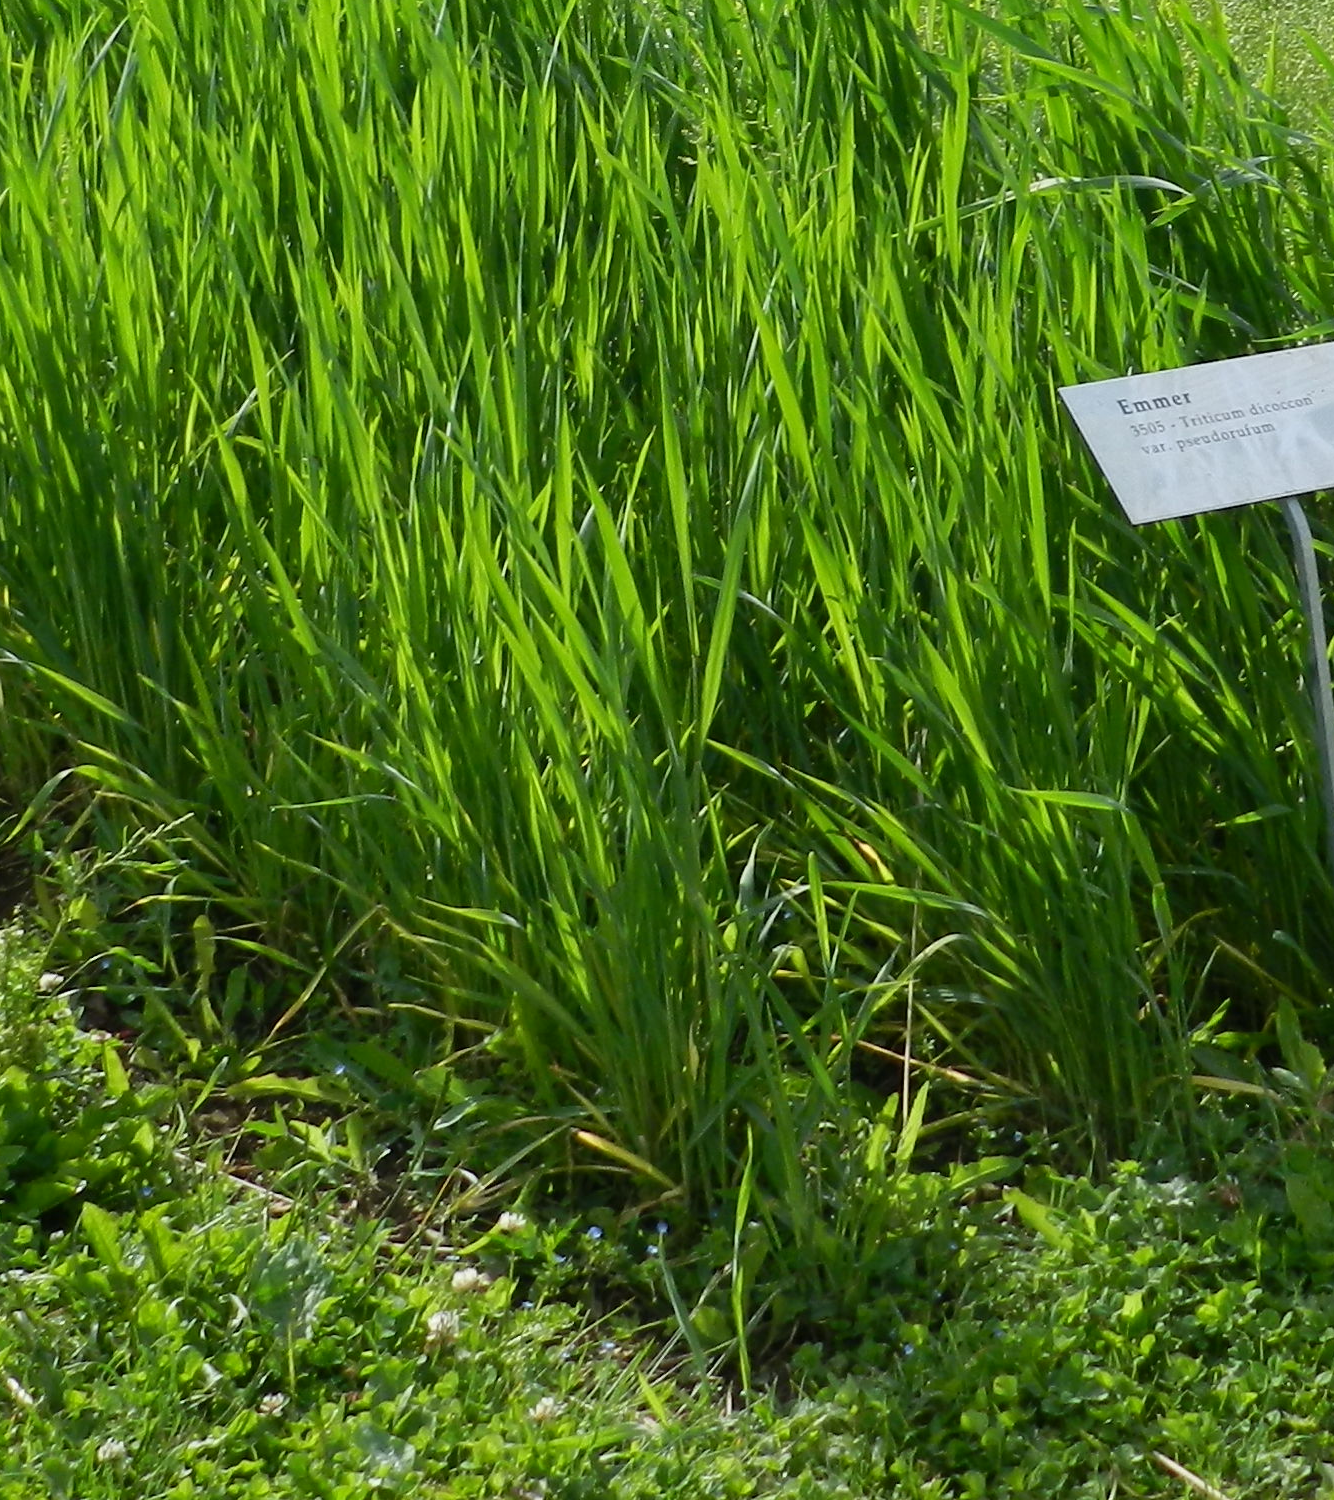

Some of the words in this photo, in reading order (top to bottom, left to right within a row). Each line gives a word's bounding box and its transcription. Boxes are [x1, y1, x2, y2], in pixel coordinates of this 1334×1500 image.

[1117, 391, 1192, 416] Emmer
[1130, 419, 1166, 438] 3505
[1179, 409, 1245, 429] Triticum
[1250, 395, 1314, 417] dicoccon
[1141, 441, 1173, 456] var.
[1177, 422, 1276, 453] pseudorufum
